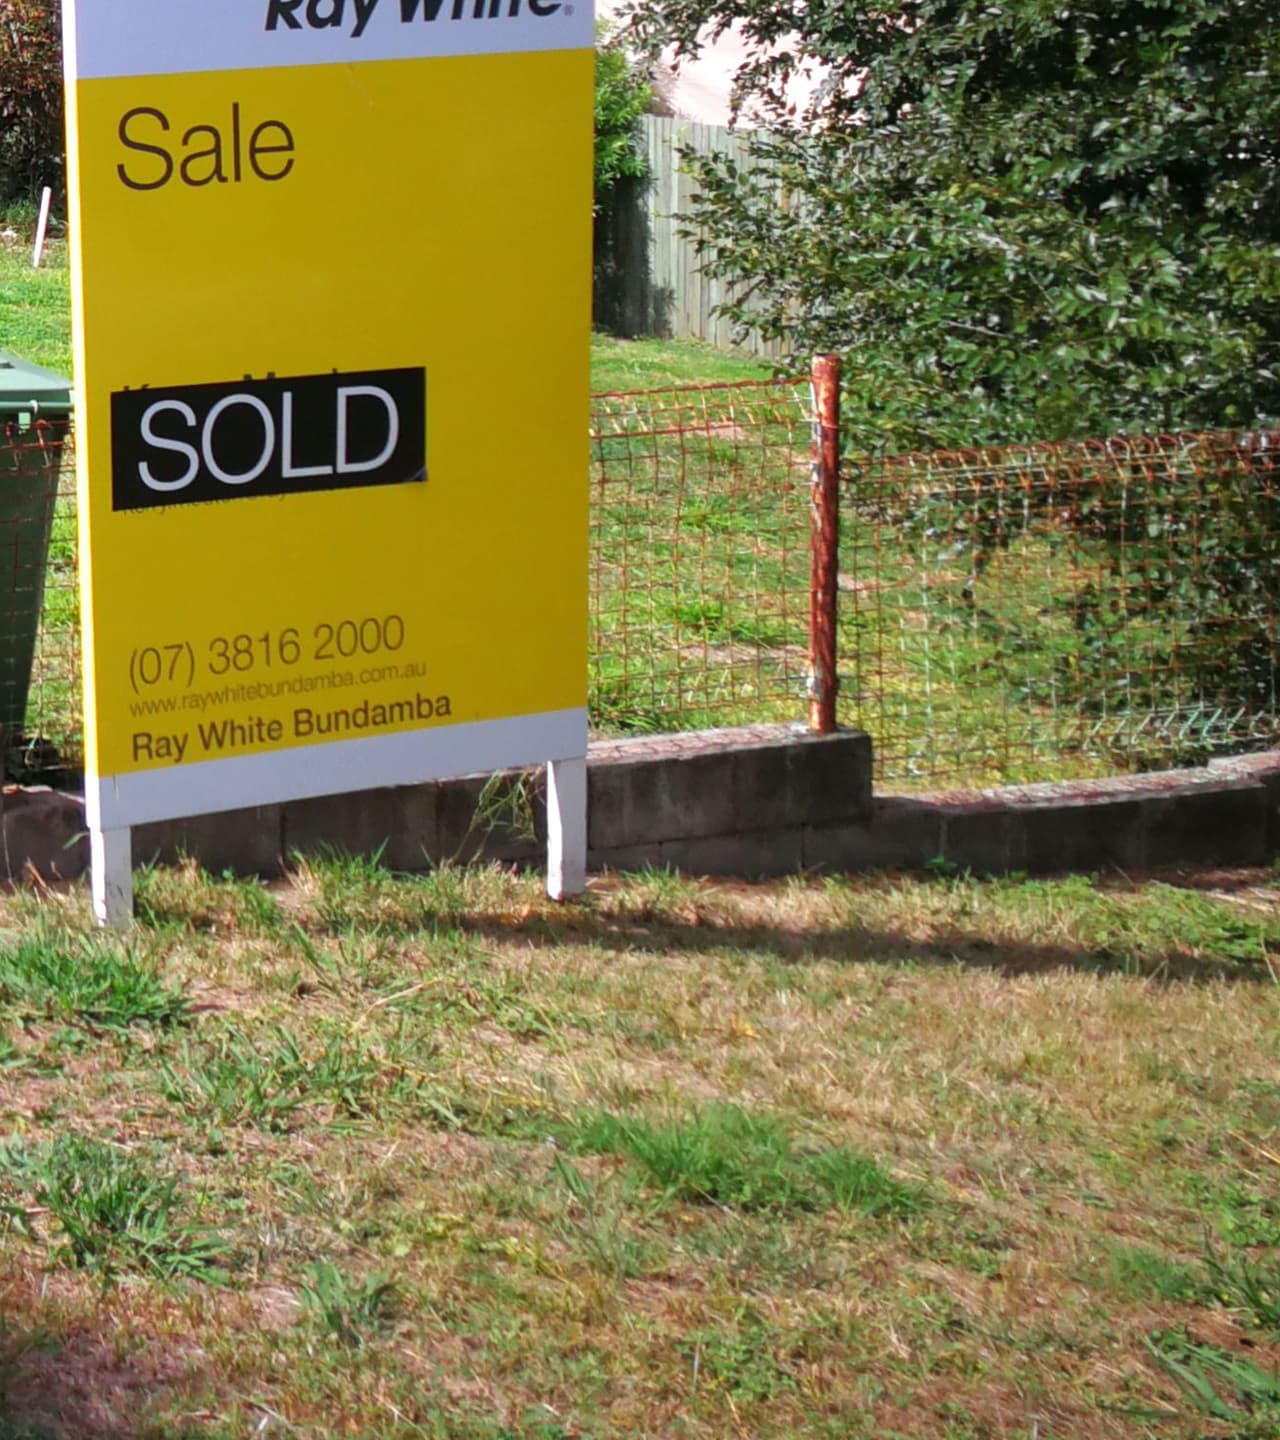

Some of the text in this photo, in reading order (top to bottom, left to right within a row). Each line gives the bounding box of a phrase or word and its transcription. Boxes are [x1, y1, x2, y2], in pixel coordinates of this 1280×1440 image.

[116, 102, 295, 191] Sale
[137, 385, 399, 491] SOLD
[129, 614, 405, 695] (07) 3816 2000
[129, 661, 427, 717] www.raywhitebundamba.com.au
[132, 692, 452, 764] Ray White Bundamba
